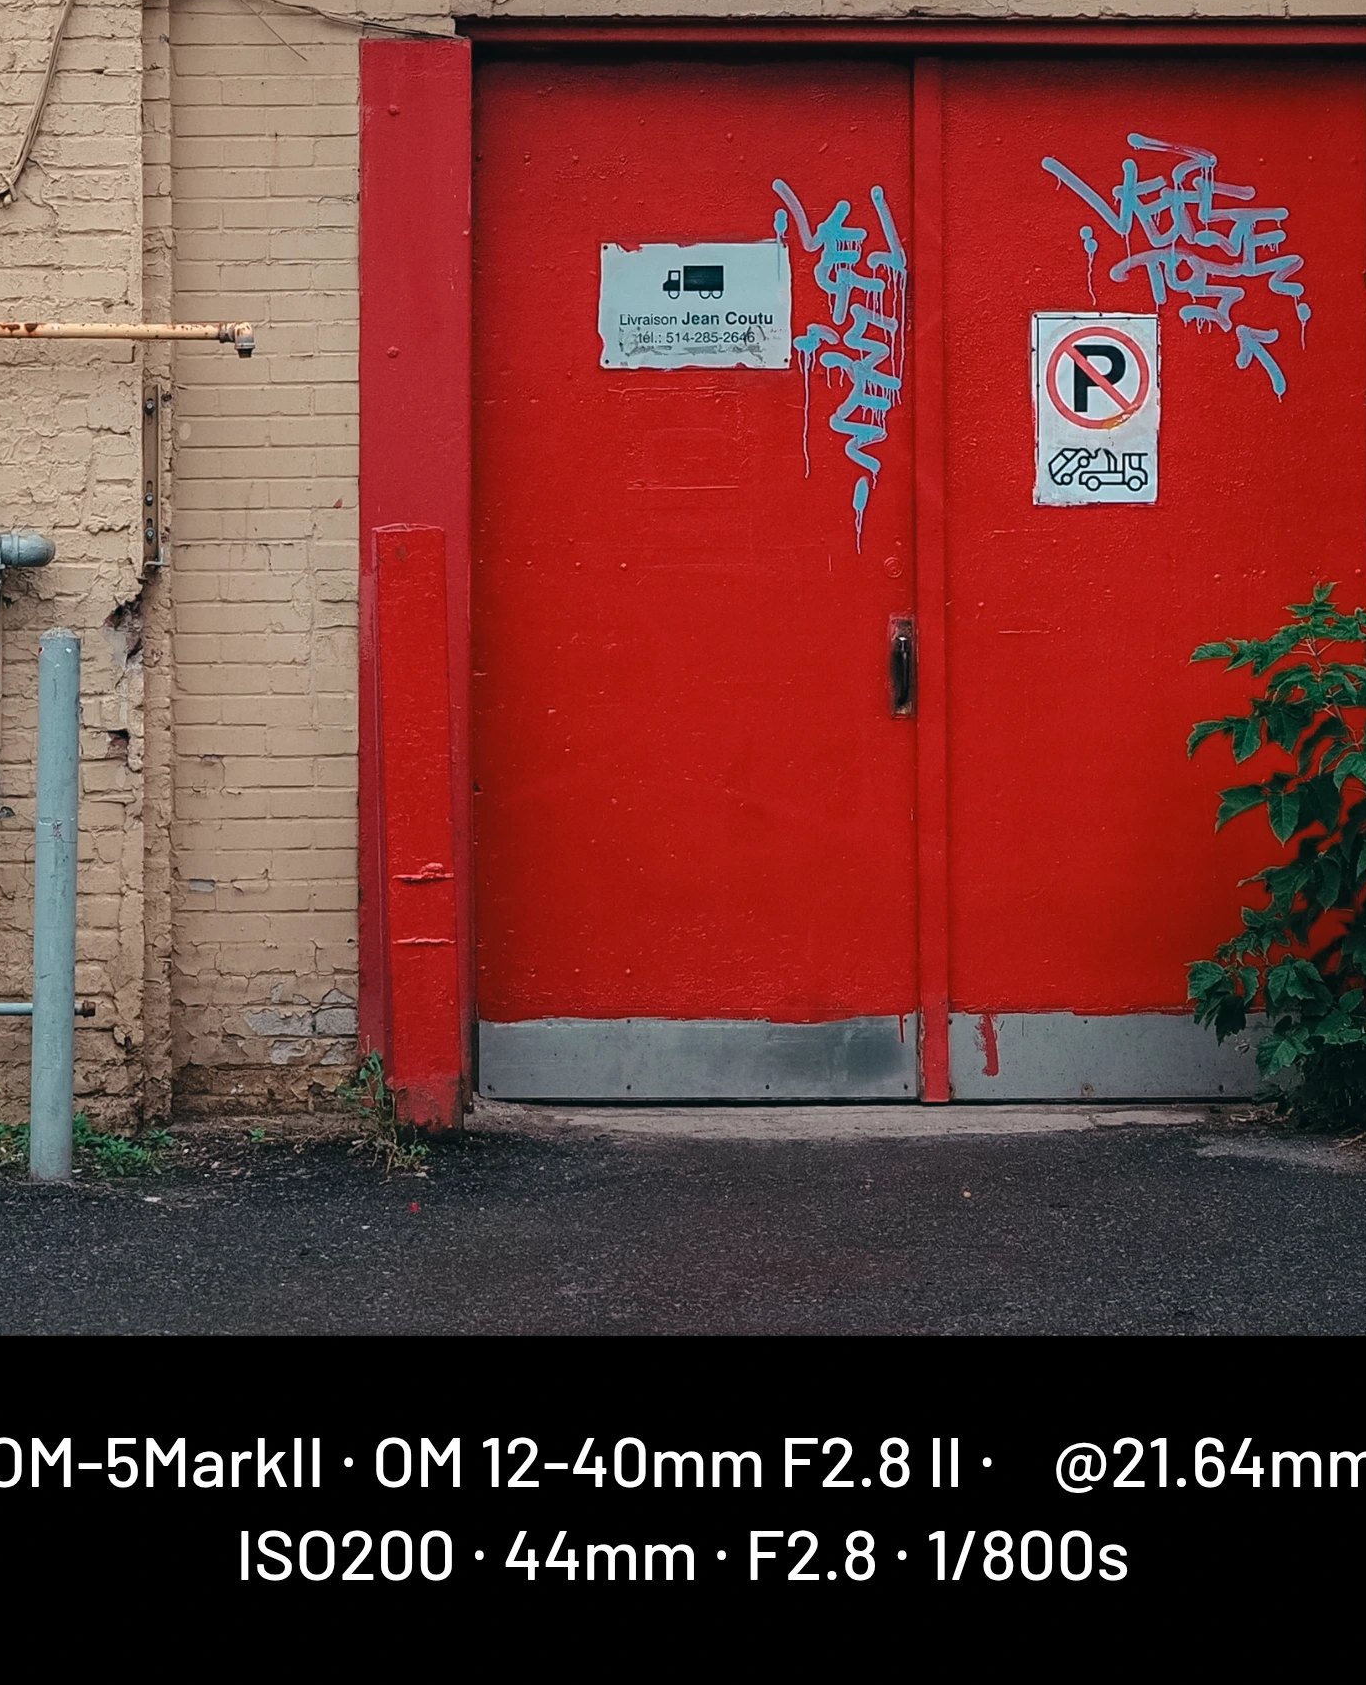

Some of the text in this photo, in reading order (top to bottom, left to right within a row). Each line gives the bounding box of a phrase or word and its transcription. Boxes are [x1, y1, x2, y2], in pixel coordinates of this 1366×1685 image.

[619, 312, 773, 326] Livraison Jean Coutu
[638, 331, 662, 344] tél.:
